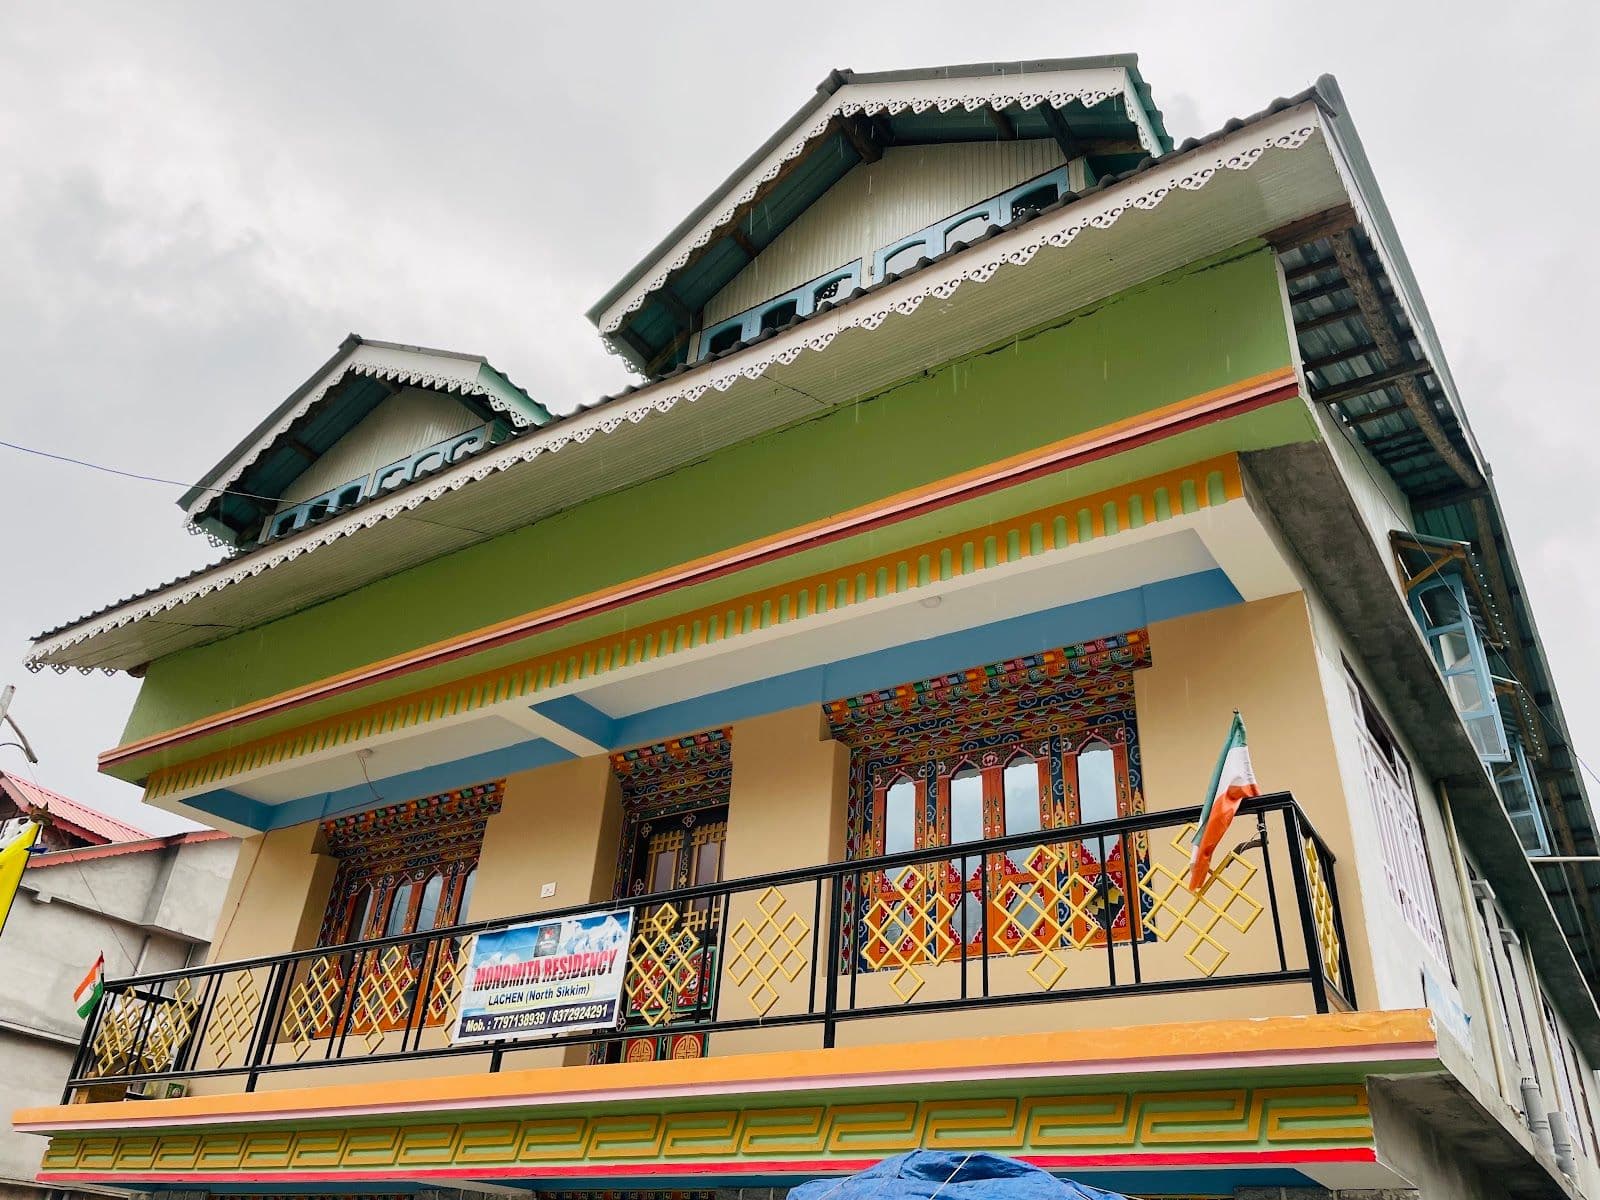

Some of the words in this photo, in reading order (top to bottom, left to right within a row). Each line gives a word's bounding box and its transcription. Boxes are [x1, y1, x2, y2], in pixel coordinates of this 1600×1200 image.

[472, 960, 541, 991] MONOMITA
[542, 949, 618, 983] RESIDENCY
[488, 993, 523, 1006] LACHEN
[525, 988, 553, 1004] (North
[556, 983, 590, 999] Sikkim)
[492, 1011, 544, 1030] 7797138939
[551, 1004, 608, 1022] 8372924291
